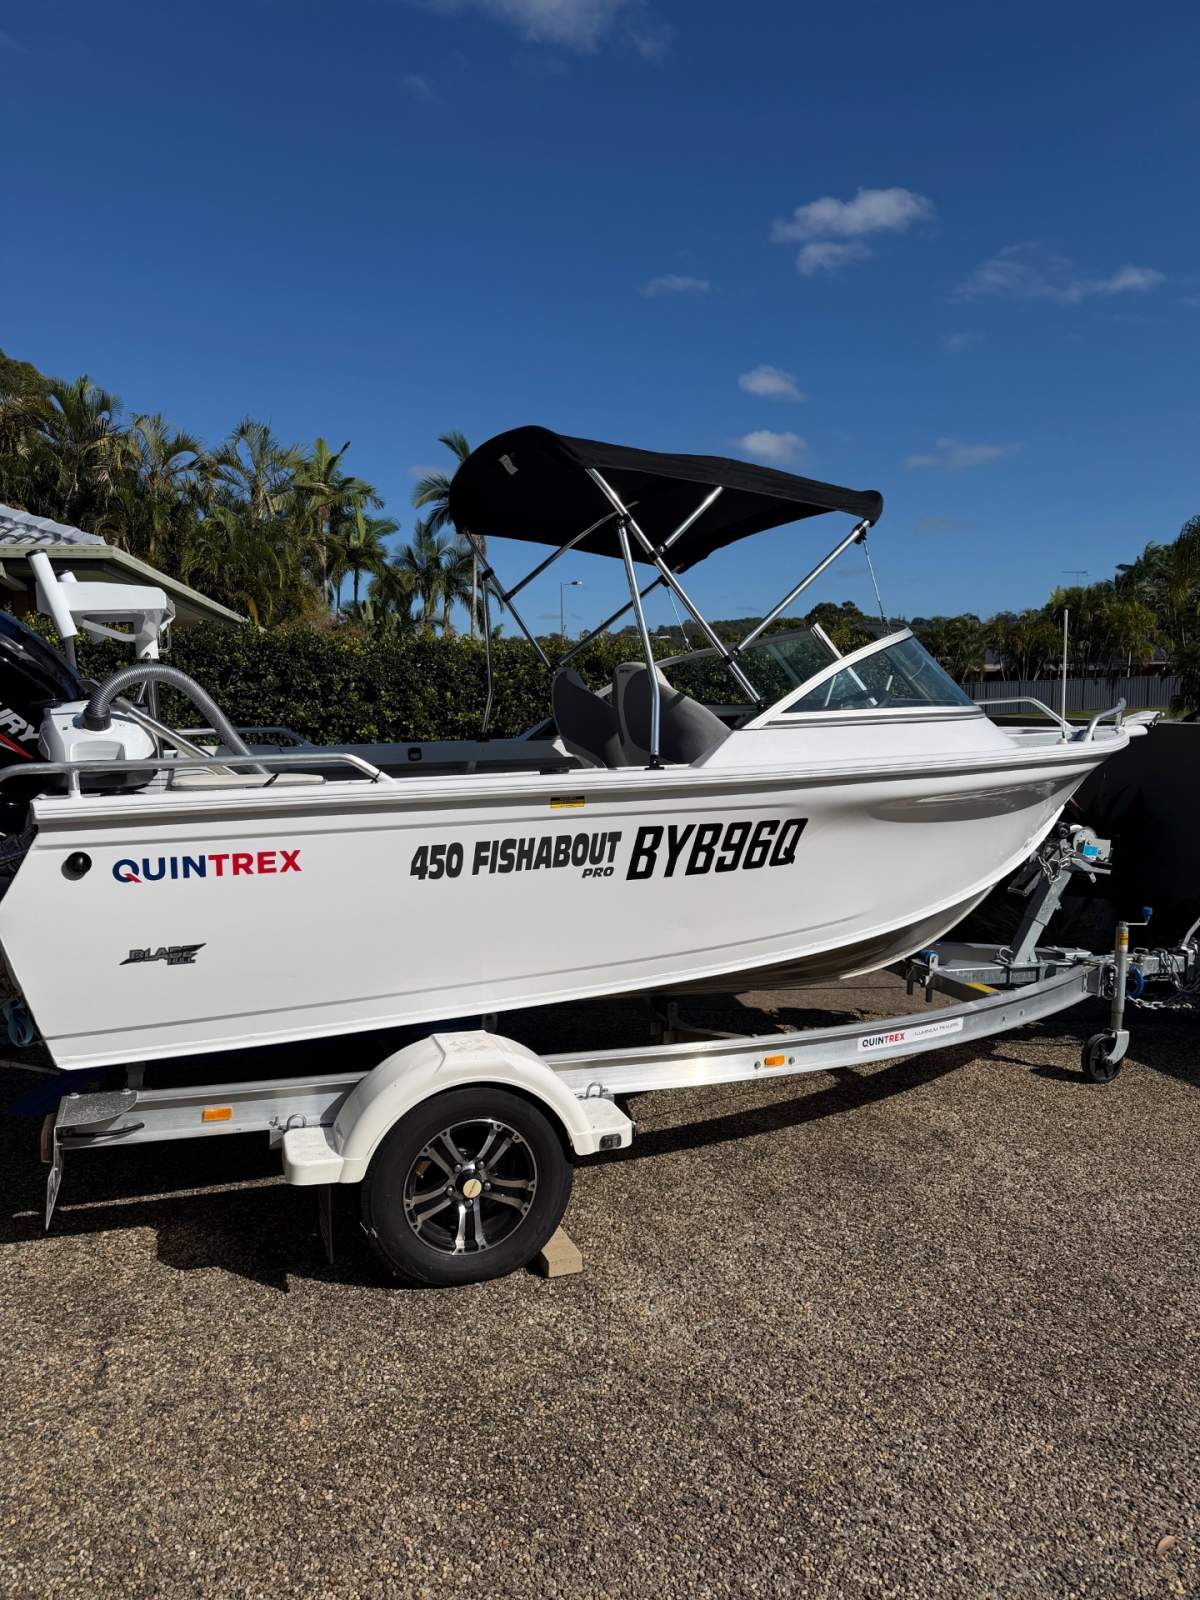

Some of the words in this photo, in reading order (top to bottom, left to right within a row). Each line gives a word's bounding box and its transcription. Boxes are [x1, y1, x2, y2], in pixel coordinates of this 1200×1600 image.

[112, 849, 302, 883] QUINTREX
[410, 842, 464, 880] 450
[472, 831, 622, 875] FISHABOUT
[626, 818, 809, 881] BYB96Q
[582, 866, 614, 878] PRO
[862, 1032, 905, 1048] QUINTREX
